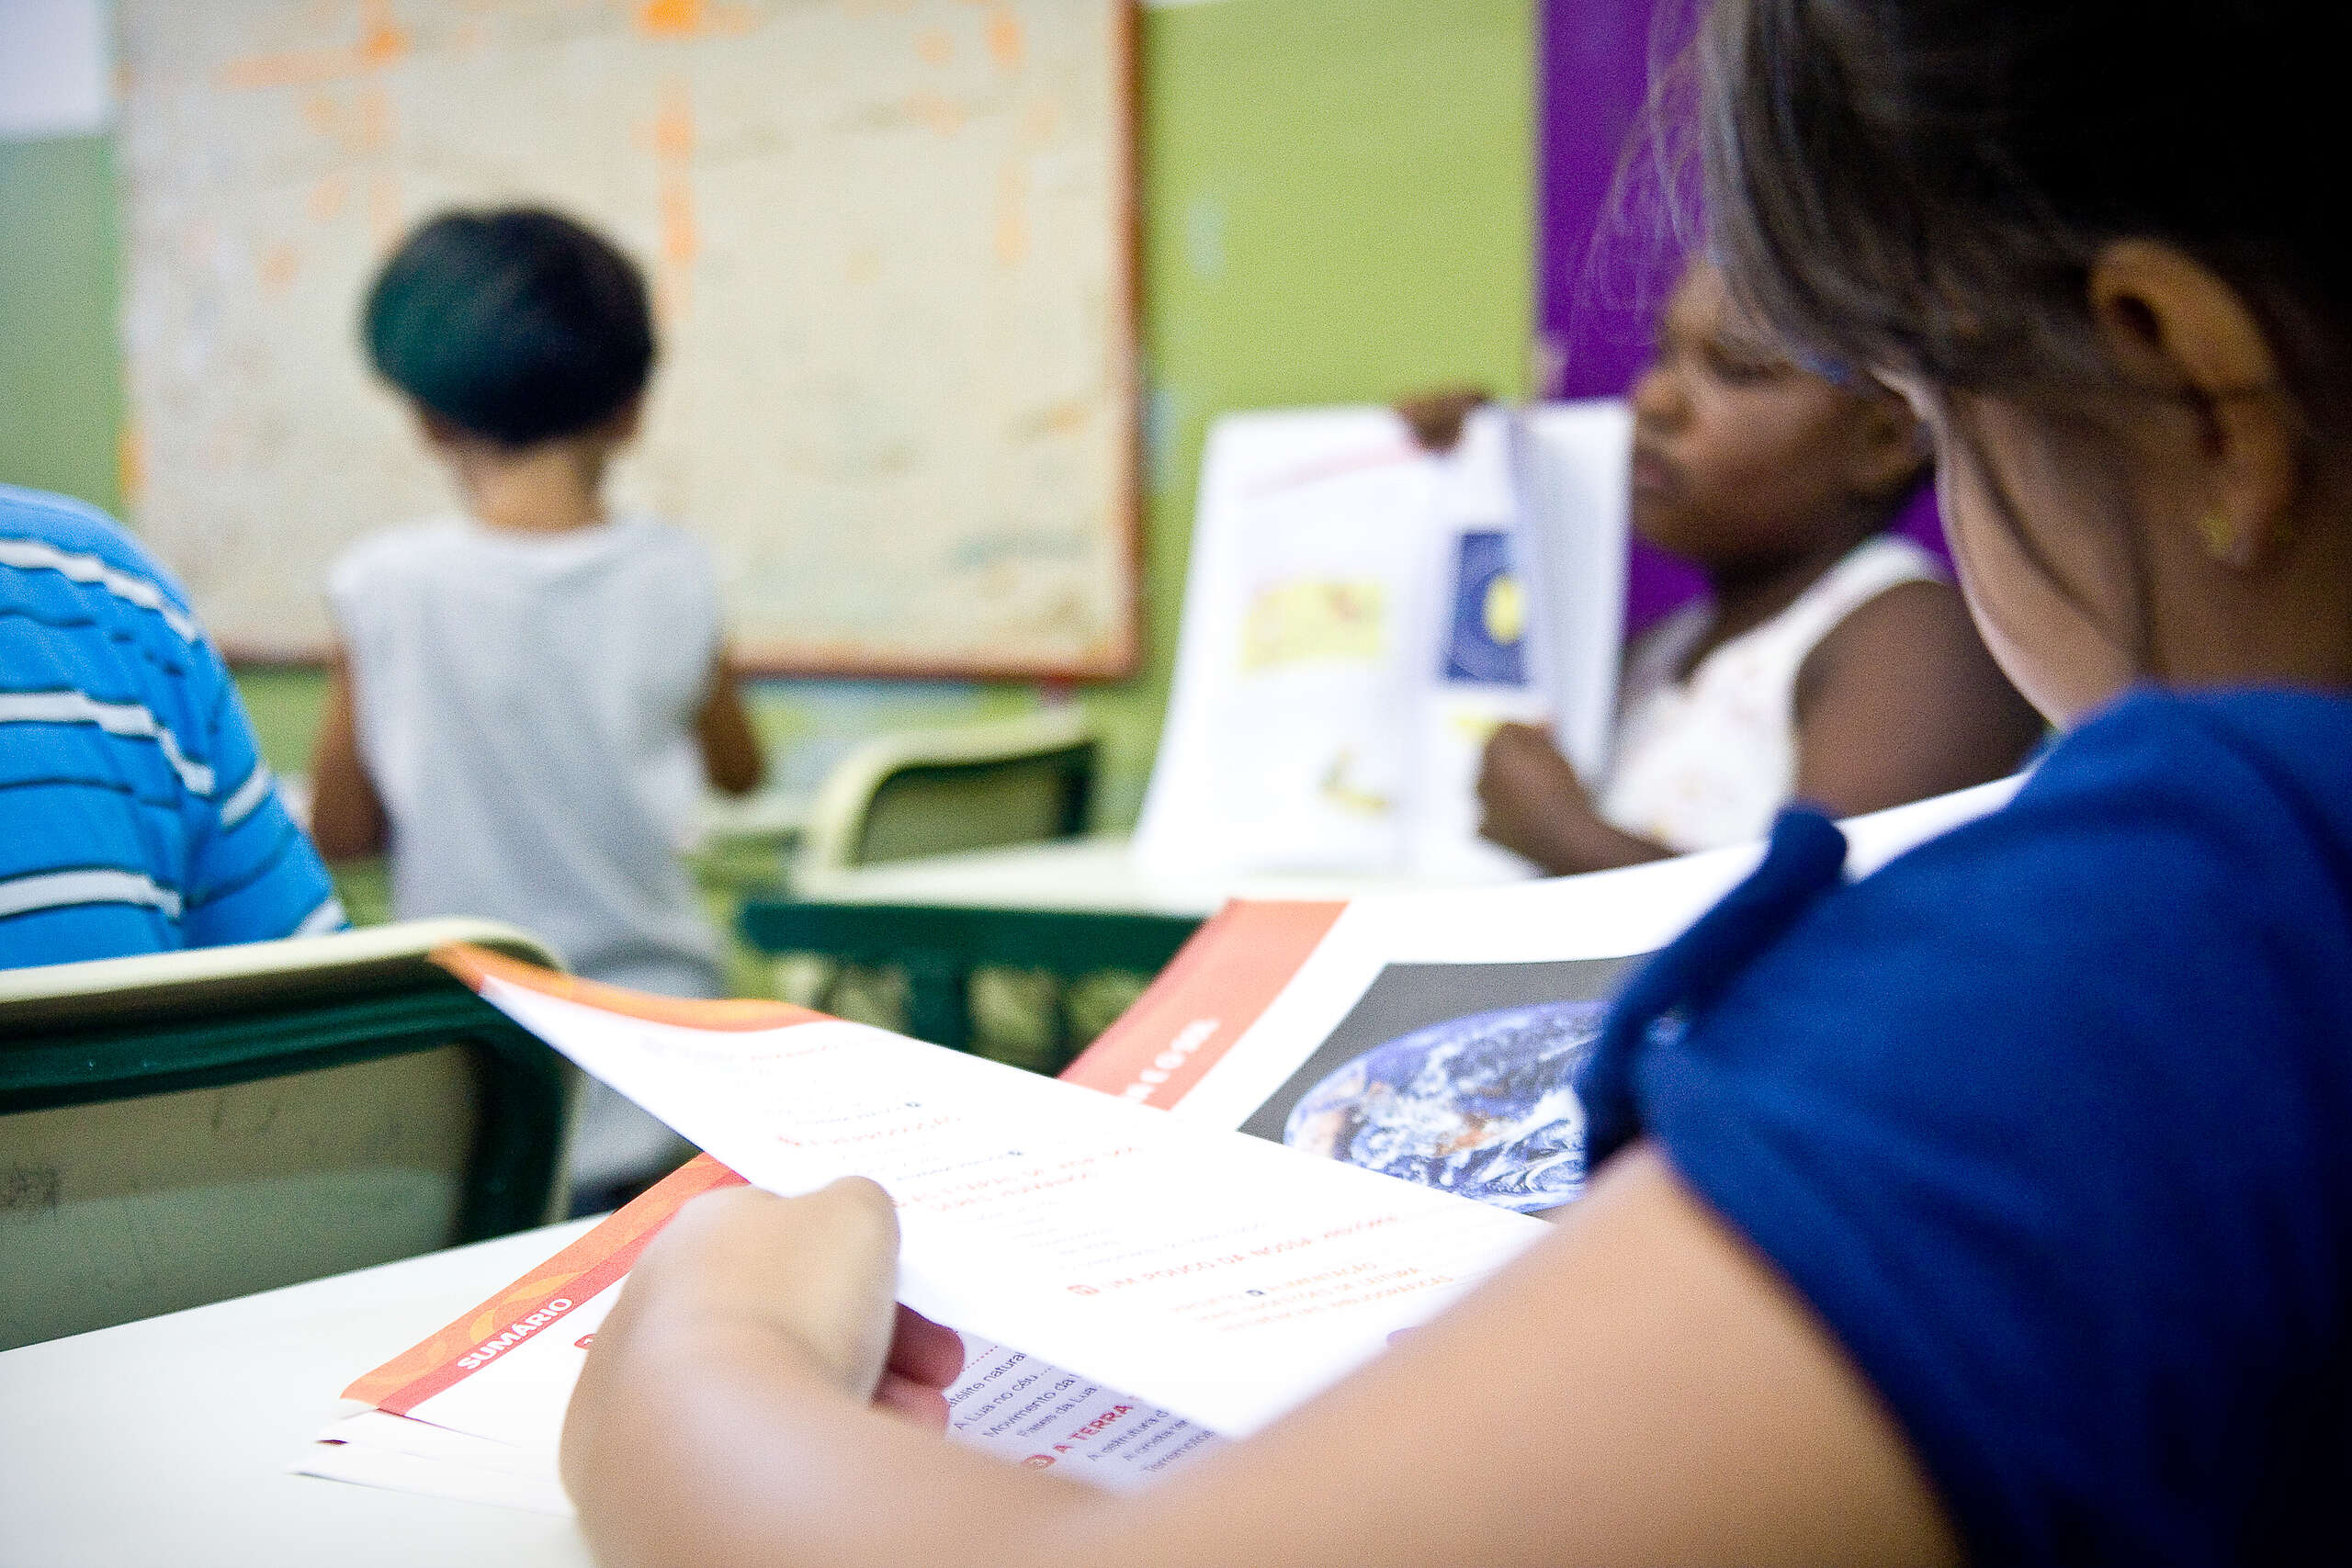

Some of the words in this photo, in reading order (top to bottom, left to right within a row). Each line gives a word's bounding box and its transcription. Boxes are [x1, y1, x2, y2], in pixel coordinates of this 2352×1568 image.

[458, 1298, 572, 1370] SUMÁRIO
[949, 1382, 985, 1408] atélite
[983, 1352, 1026, 1382] natural
[954, 1422, 968, 1430] A
[965, 1404, 995, 1422] Lua
[993, 1393, 1013, 1404] no
[1012, 1375, 1038, 1392] céu
[1057, 1402, 1076, 1416] da
[1071, 1386, 1097, 1404] Lua
[982, 1392, 1056, 1438] Movimento
[1055, 1378, 1077, 1392] da
[1053, 1444, 1073, 1454] A
[1068, 1404, 1133, 1440] TERRA
